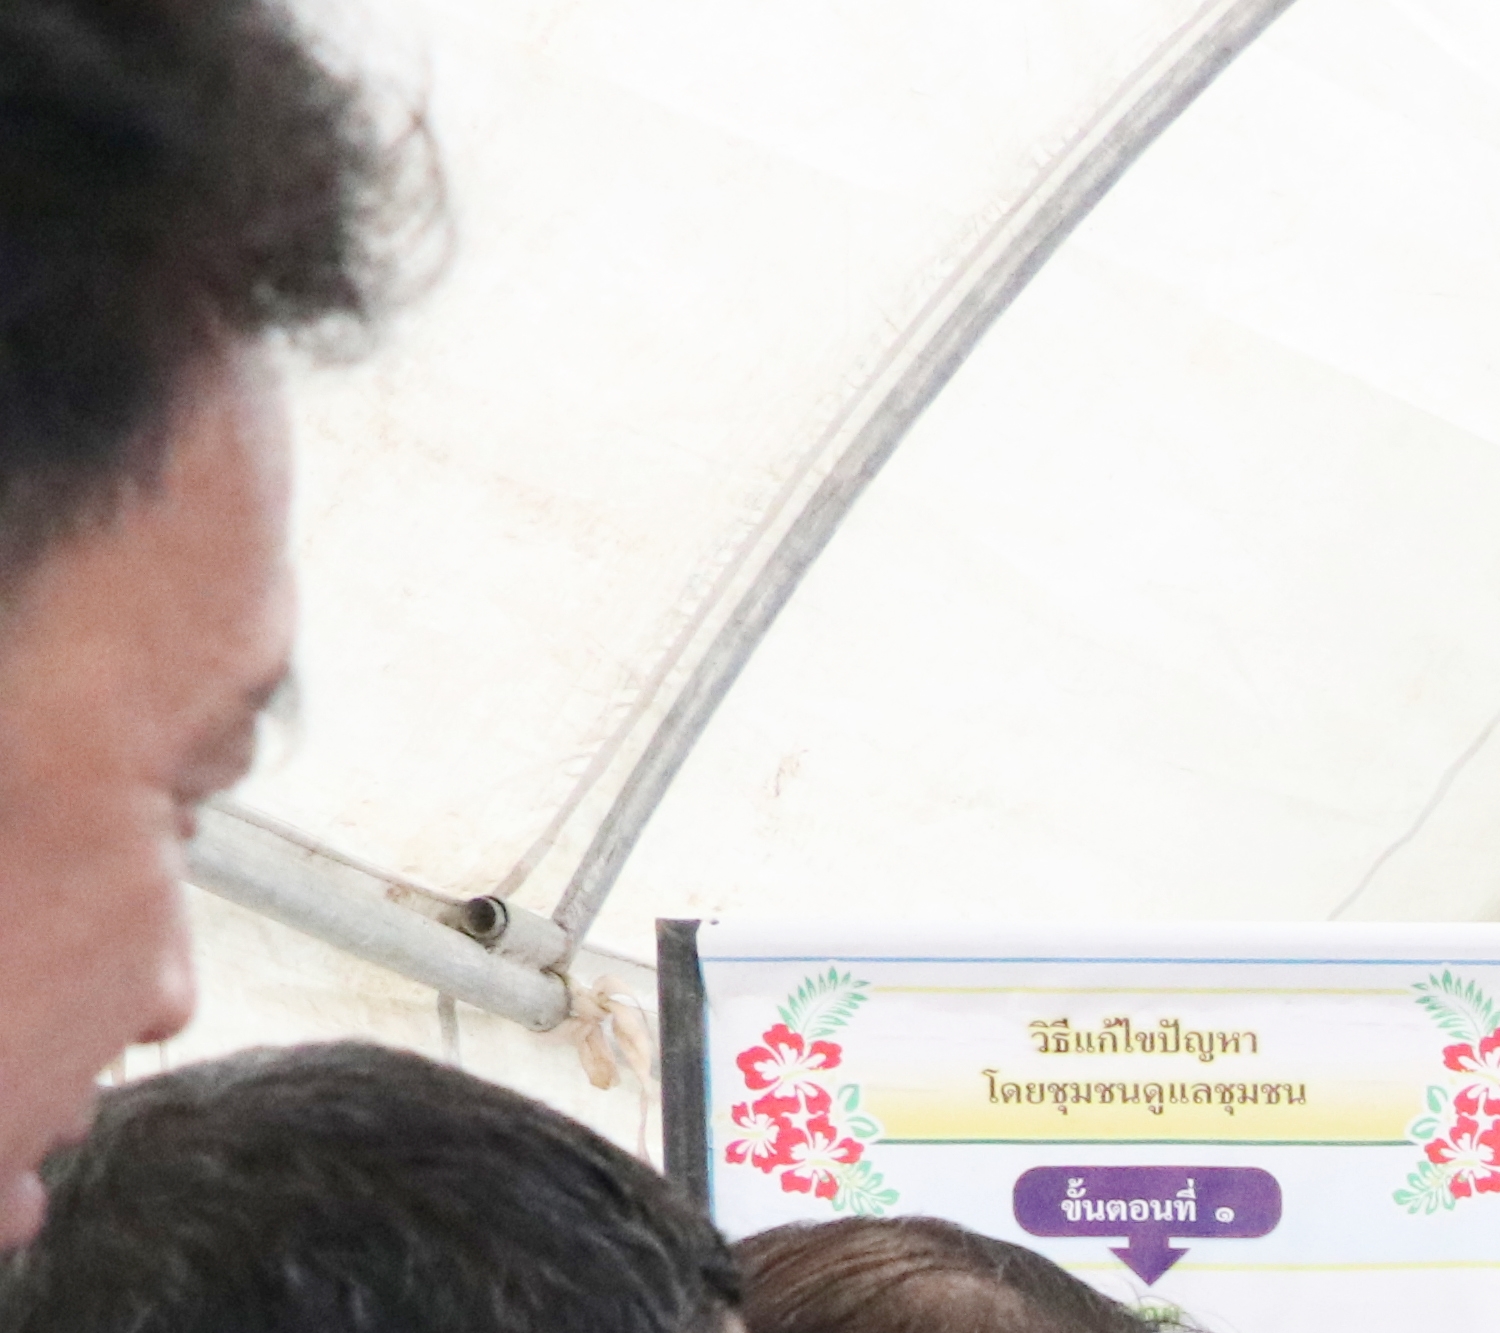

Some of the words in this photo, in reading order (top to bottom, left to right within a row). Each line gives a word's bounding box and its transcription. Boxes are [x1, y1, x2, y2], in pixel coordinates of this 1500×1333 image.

[1029, 1017, 1259, 1062] วิธีแก้ไขปัญหา
[981, 1069, 1307, 1117] โดยชุมชนดูแลชุมชน
[1060, 1177, 1197, 1222] ขั้นตอนที่
[1214, 1206, 1236, 1224] ๑
